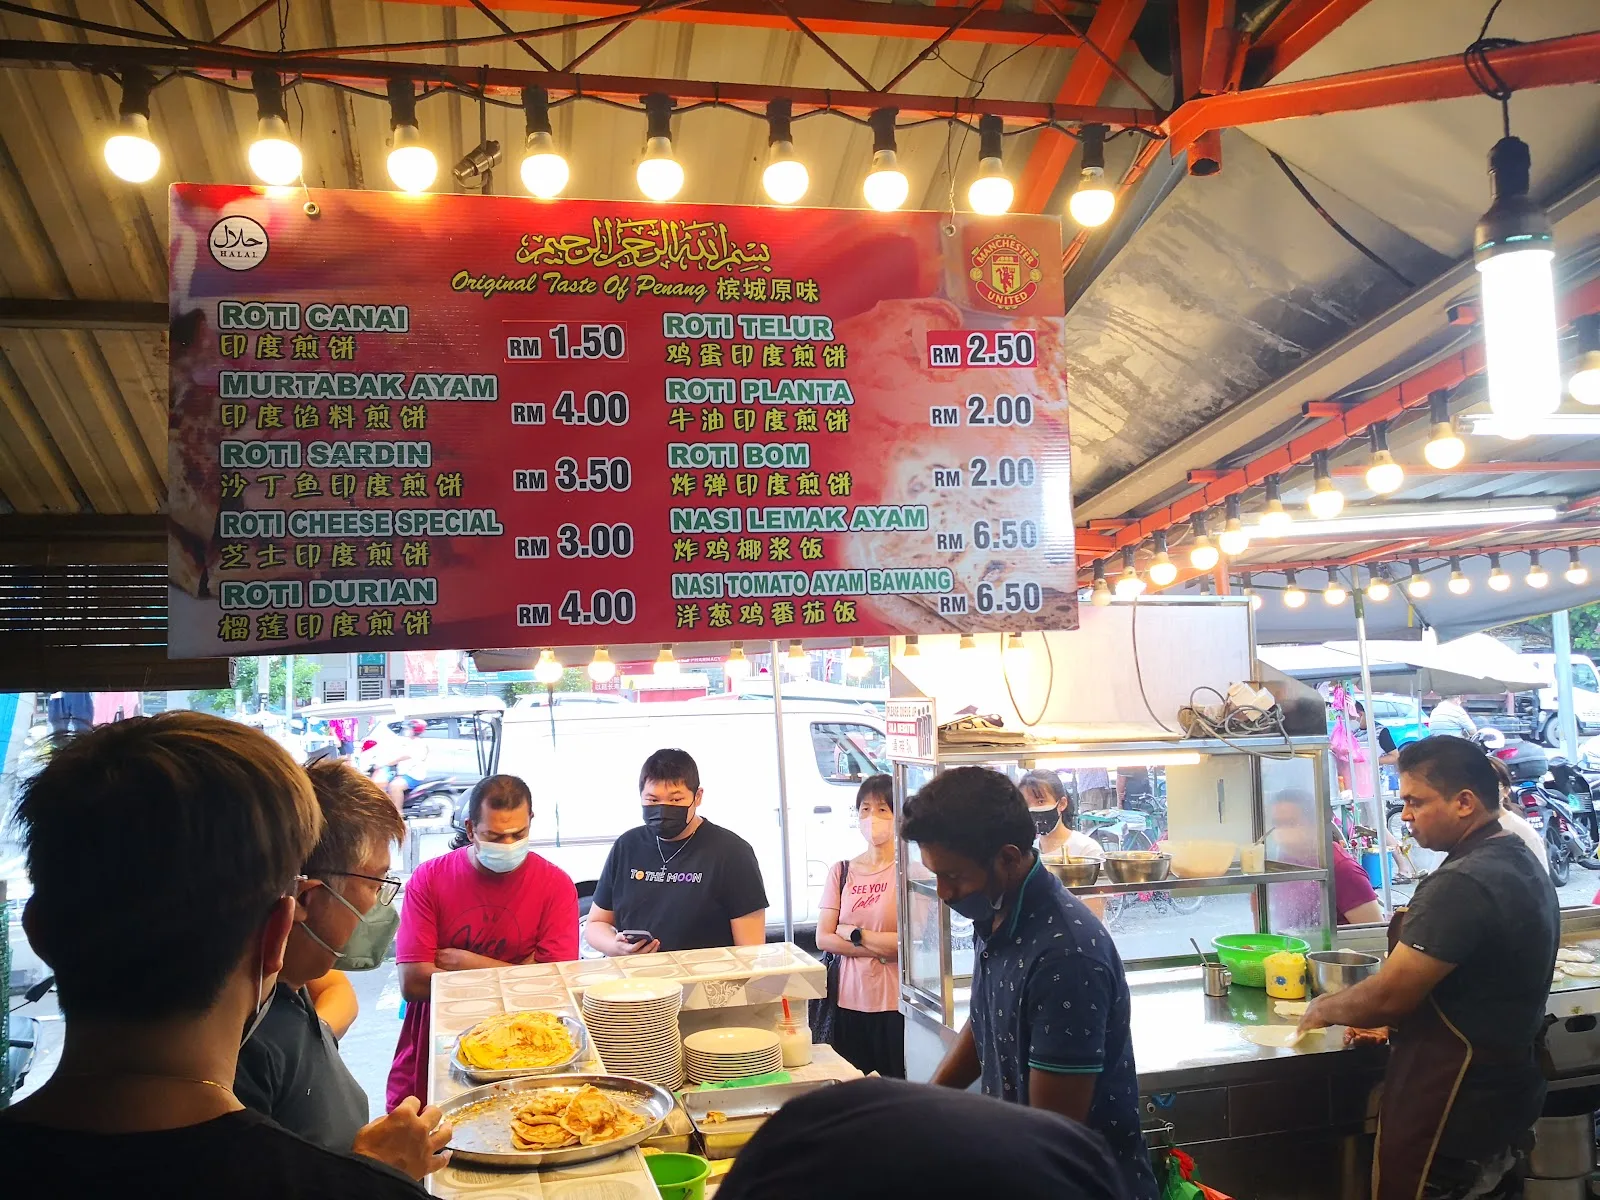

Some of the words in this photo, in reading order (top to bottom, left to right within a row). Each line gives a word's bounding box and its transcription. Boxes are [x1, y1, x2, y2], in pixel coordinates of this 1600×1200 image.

[220, 250, 258, 258] HALAL
[976, 238, 1035, 267] MANCHESTER
[451, 270, 538, 302] Original
[542, 271, 598, 295] Taste
[604, 275, 630, 302] Of
[635, 276, 709, 303] Penang
[716, 277, 820, 303] 槟城原味
[987, 290, 1029, 306] UNITED
[222, 305, 297, 330] ROTI
[309, 306, 407, 332] CANAI
[665, 314, 732, 338] ROTI
[738, 316, 833, 340] TELUR
[220, 334, 356, 361] 印度煎饼
[508, 340, 540, 359] RM
[550, 325, 624, 359] 1.50
[932, 347, 960, 364] RM
[968, 334, 1033, 364] 2.50
[666, 343, 848, 369] 鸡蛋印度煎饼
[221, 373, 406, 398] MURTABAK
[410, 375, 497, 400] AYAM
[667, 380, 734, 403] ROTI
[743, 379, 852, 403] PLANTA
[220, 404, 428, 431] 印度馅料煎饼
[513, 404, 545, 424] RM
[553, 392, 629, 426] 4.00
[668, 408, 851, 434] 牛油印度煎饼
[931, 408, 959, 426] RM
[967, 396, 1033, 426] 2.00
[222, 442, 299, 467] ROTI
[309, 442, 430, 467] SARDIN
[669, 444, 736, 467] ROTI
[744, 443, 810, 467] BOM
[220, 472, 464, 499] 沙丁鱼印度煎饼
[515, 471, 547, 491] RM
[556, 458, 630, 492] 3.50
[670, 472, 853, 498] 炸弹印度煎饼
[934, 471, 962, 488] RM
[970, 457, 1035, 489] 2.00
[222, 512, 285, 538] ROTI
[290, 511, 393, 536] CHEESE
[396, 510, 503, 535] SPECIAL
[672, 508, 742, 532] NASI
[747, 507, 846, 531] LEMAK
[852, 506, 928, 530] AYAM
[516, 538, 548, 557] RM
[558, 524, 633, 558] 3.00
[672, 536, 825, 562] 炸鸡椰浆饭
[937, 533, 963, 551] RM
[973, 520, 1040, 550] 6.50
[220, 541, 431, 569] 芝士印度煎饼
[222, 581, 299, 607] ROTI
[310, 579, 437, 606] DURIAN
[674, 575, 722, 597] NASI
[726, 573, 808, 596] TOMATO
[811, 572, 865, 594] AYAM
[869, 570, 954, 593] BAWANG
[518, 605, 550, 625] RM
[560, 591, 635, 625] 4.00
[940, 595, 967, 614] RM
[976, 582, 1043, 613] 6.50
[219, 610, 432, 641] 榴莲印度煎饼
[676, 601, 858, 629] 洋葱鸡番茄饭
[645, 871, 666, 883] THE
[666, 873, 703, 883] MOON
[852, 885, 868, 895] SEE
[870, 883, 888, 894] YOU
